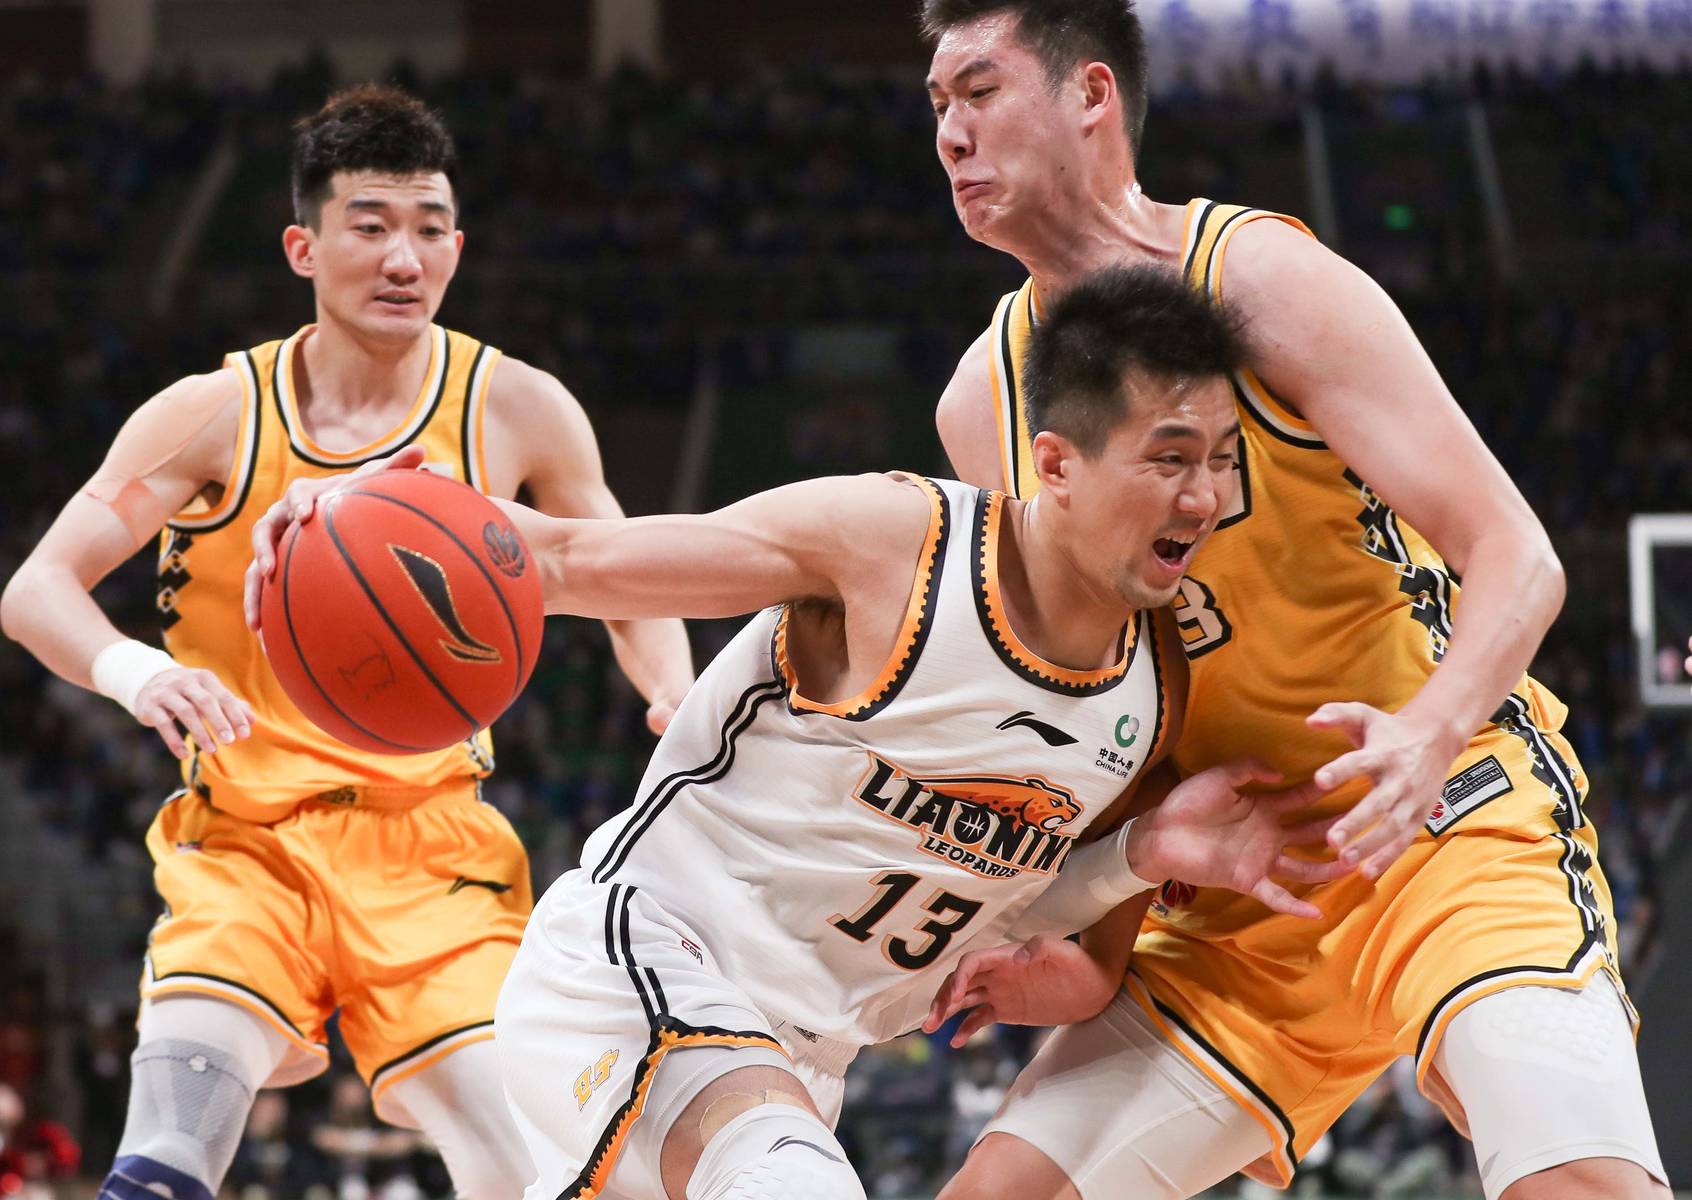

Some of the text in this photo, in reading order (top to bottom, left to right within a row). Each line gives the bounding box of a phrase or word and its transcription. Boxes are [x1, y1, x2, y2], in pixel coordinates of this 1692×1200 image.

[1095, 759, 1129, 778] CHINA LIFE
[857, 756, 1073, 874] LIAONIN
[924, 836, 1020, 879] LEOPARDS
[829, 871, 985, 972] 13
